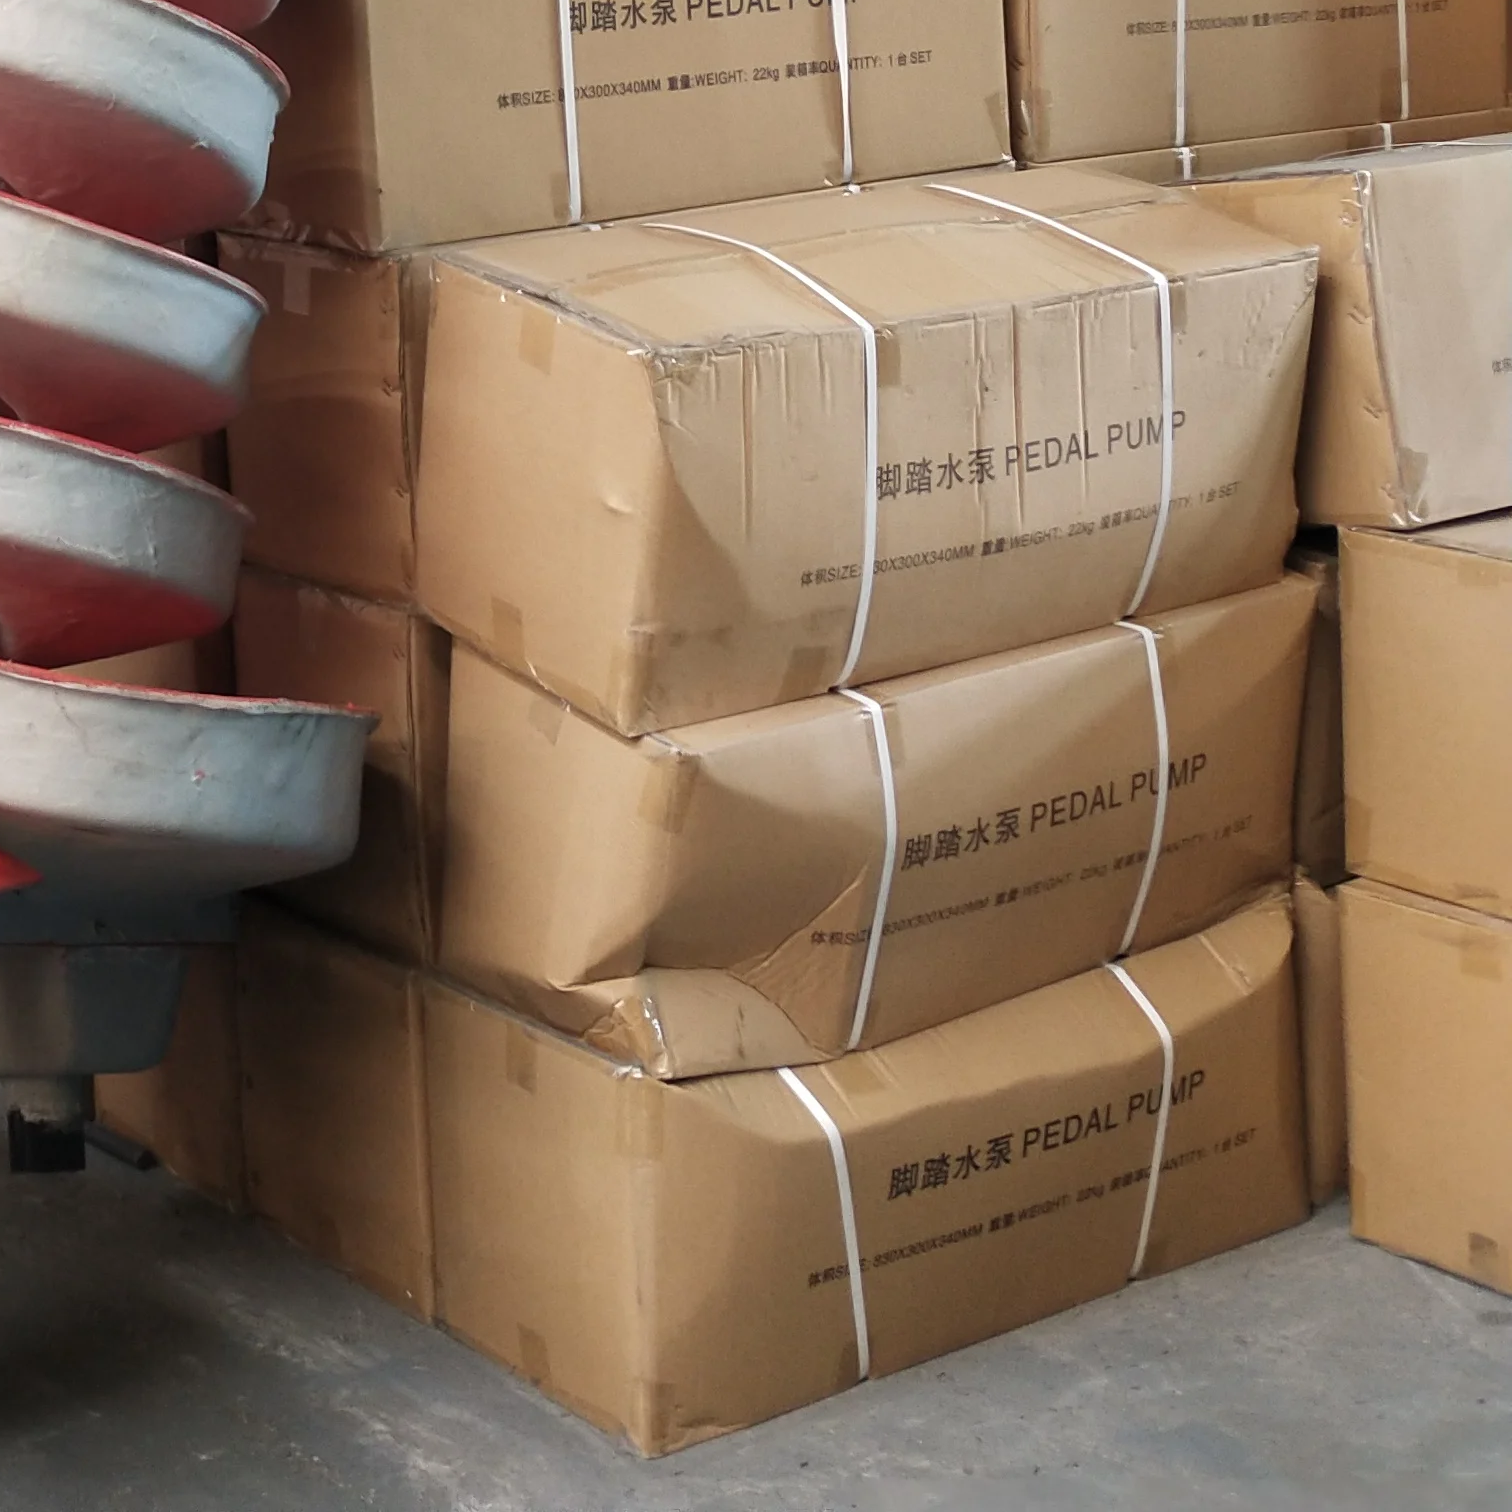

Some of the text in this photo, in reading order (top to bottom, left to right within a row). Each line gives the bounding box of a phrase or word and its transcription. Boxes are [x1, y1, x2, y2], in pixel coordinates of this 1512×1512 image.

[752, 66, 780, 82] 22kg
[910, 49, 933, 64] SET
[876, 447, 997, 502] 脚踏水泵
[1005, 429, 1100, 476] PEDAL
[1067, 521, 1096, 537] 22kg
[1218, 480, 1242, 500] SET
[901, 805, 1022, 872] 脚踏水泵
[1030, 780, 1123, 834] PEDAL
[887, 1069, 1207, 1202] 脚踏水泵 PEDAL PUMP
[1234, 1127, 1258, 1147] SET
